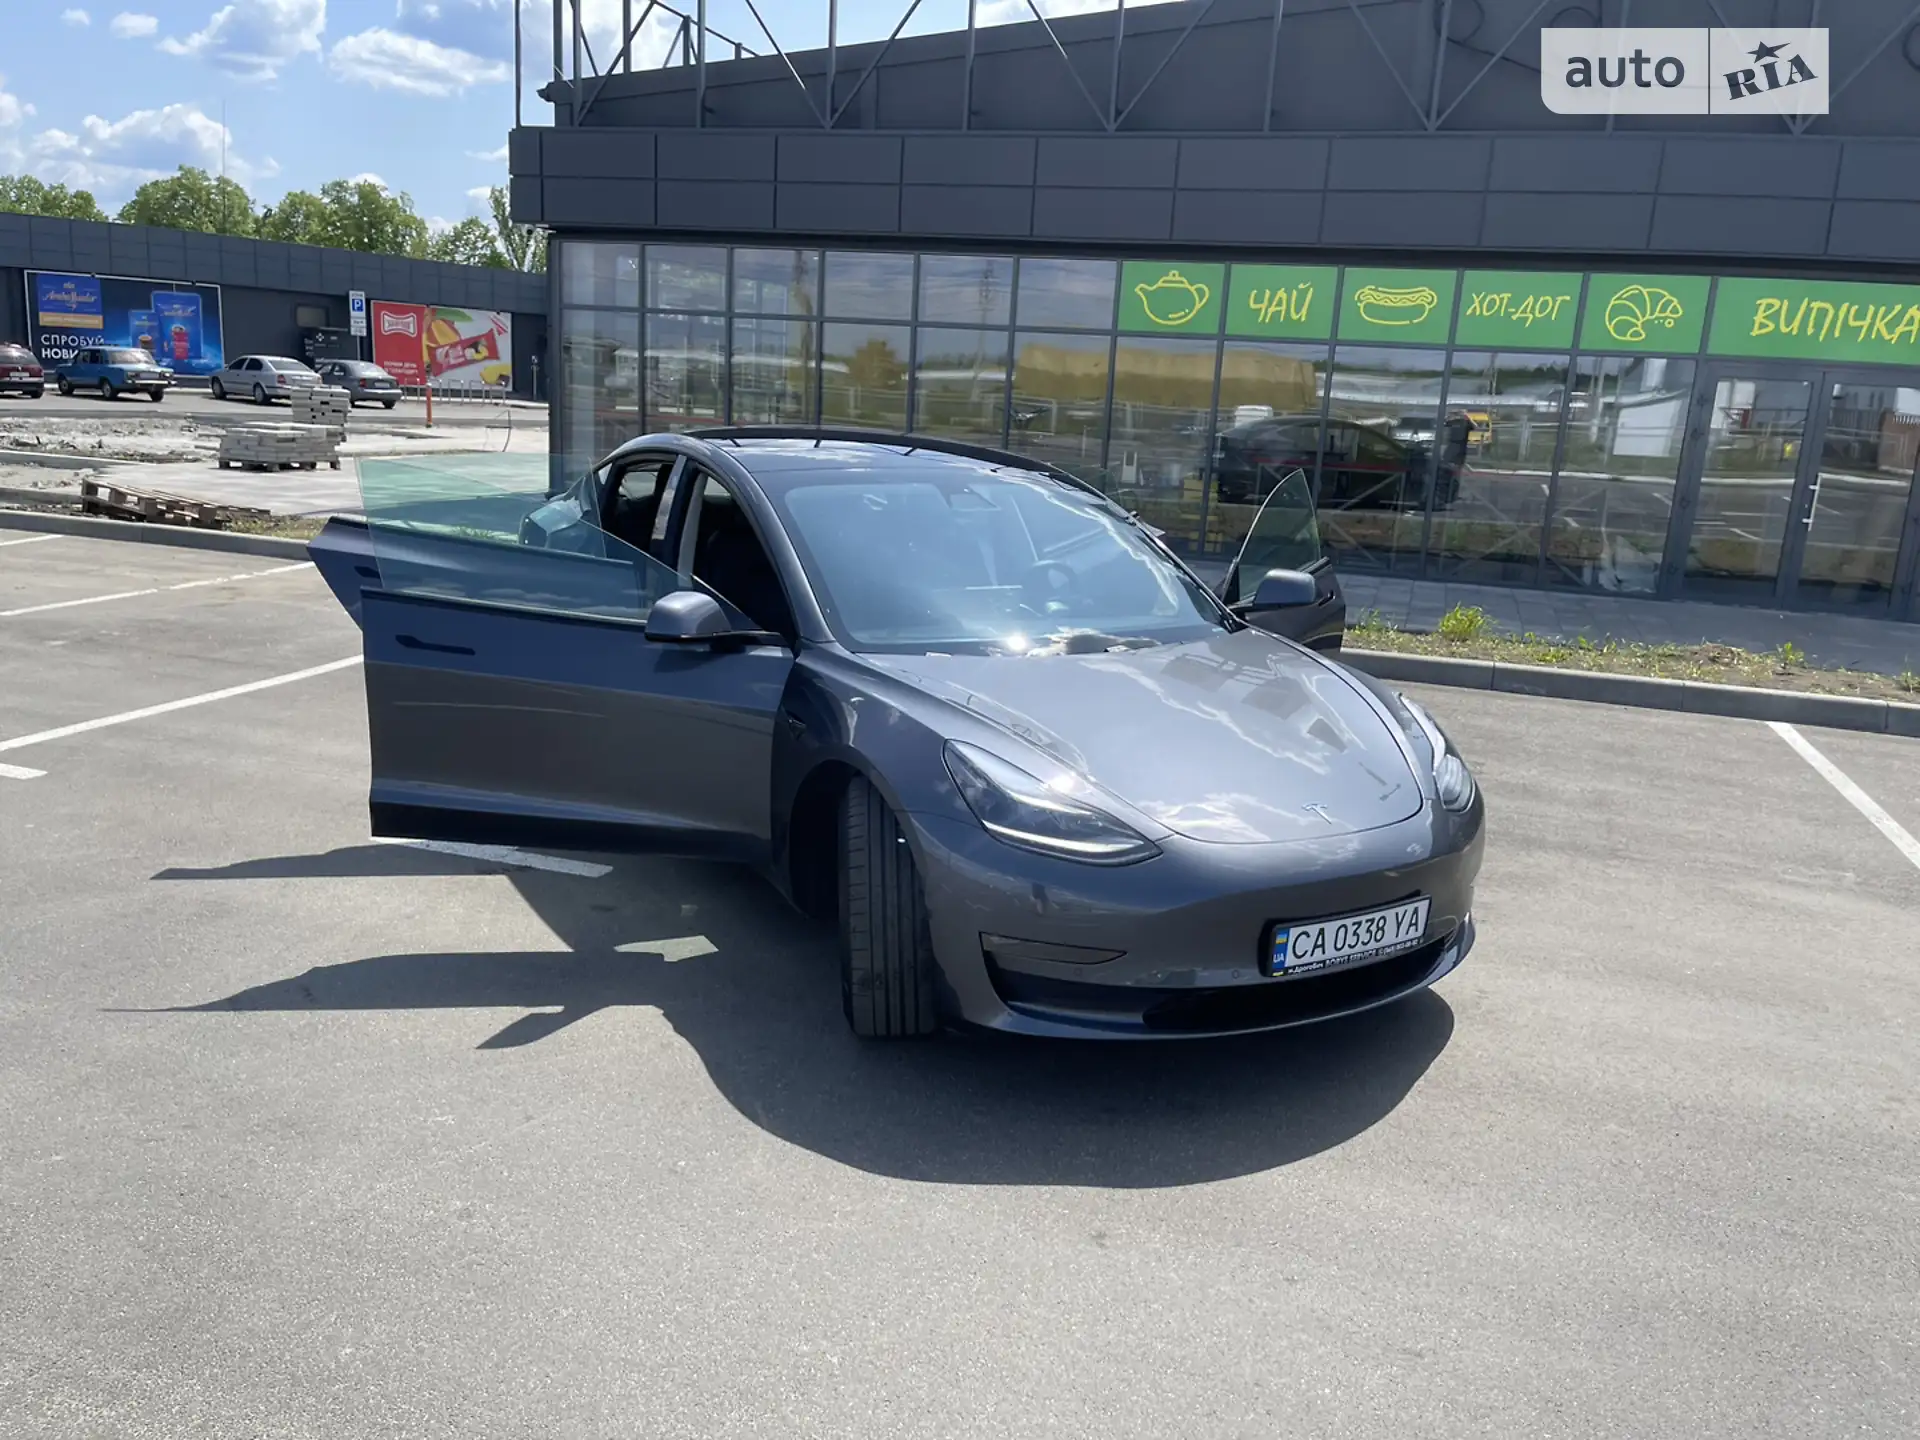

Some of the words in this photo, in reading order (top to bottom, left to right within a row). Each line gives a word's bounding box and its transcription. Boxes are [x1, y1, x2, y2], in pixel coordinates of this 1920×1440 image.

[1249, 281, 1314, 323] ЧАЙ
[1465, 291, 1571, 328] ХОТ-ДОГ
[1750, 297, 1920, 344] ВИПІЧКА
[41, 334, 105, 347] СПРОБУЙ
[1292, 928, 1326, 959] CA
[1334, 915, 1387, 951] 0338
[1395, 906, 1420, 939] YA
[1273, 953, 1285, 963] UA
